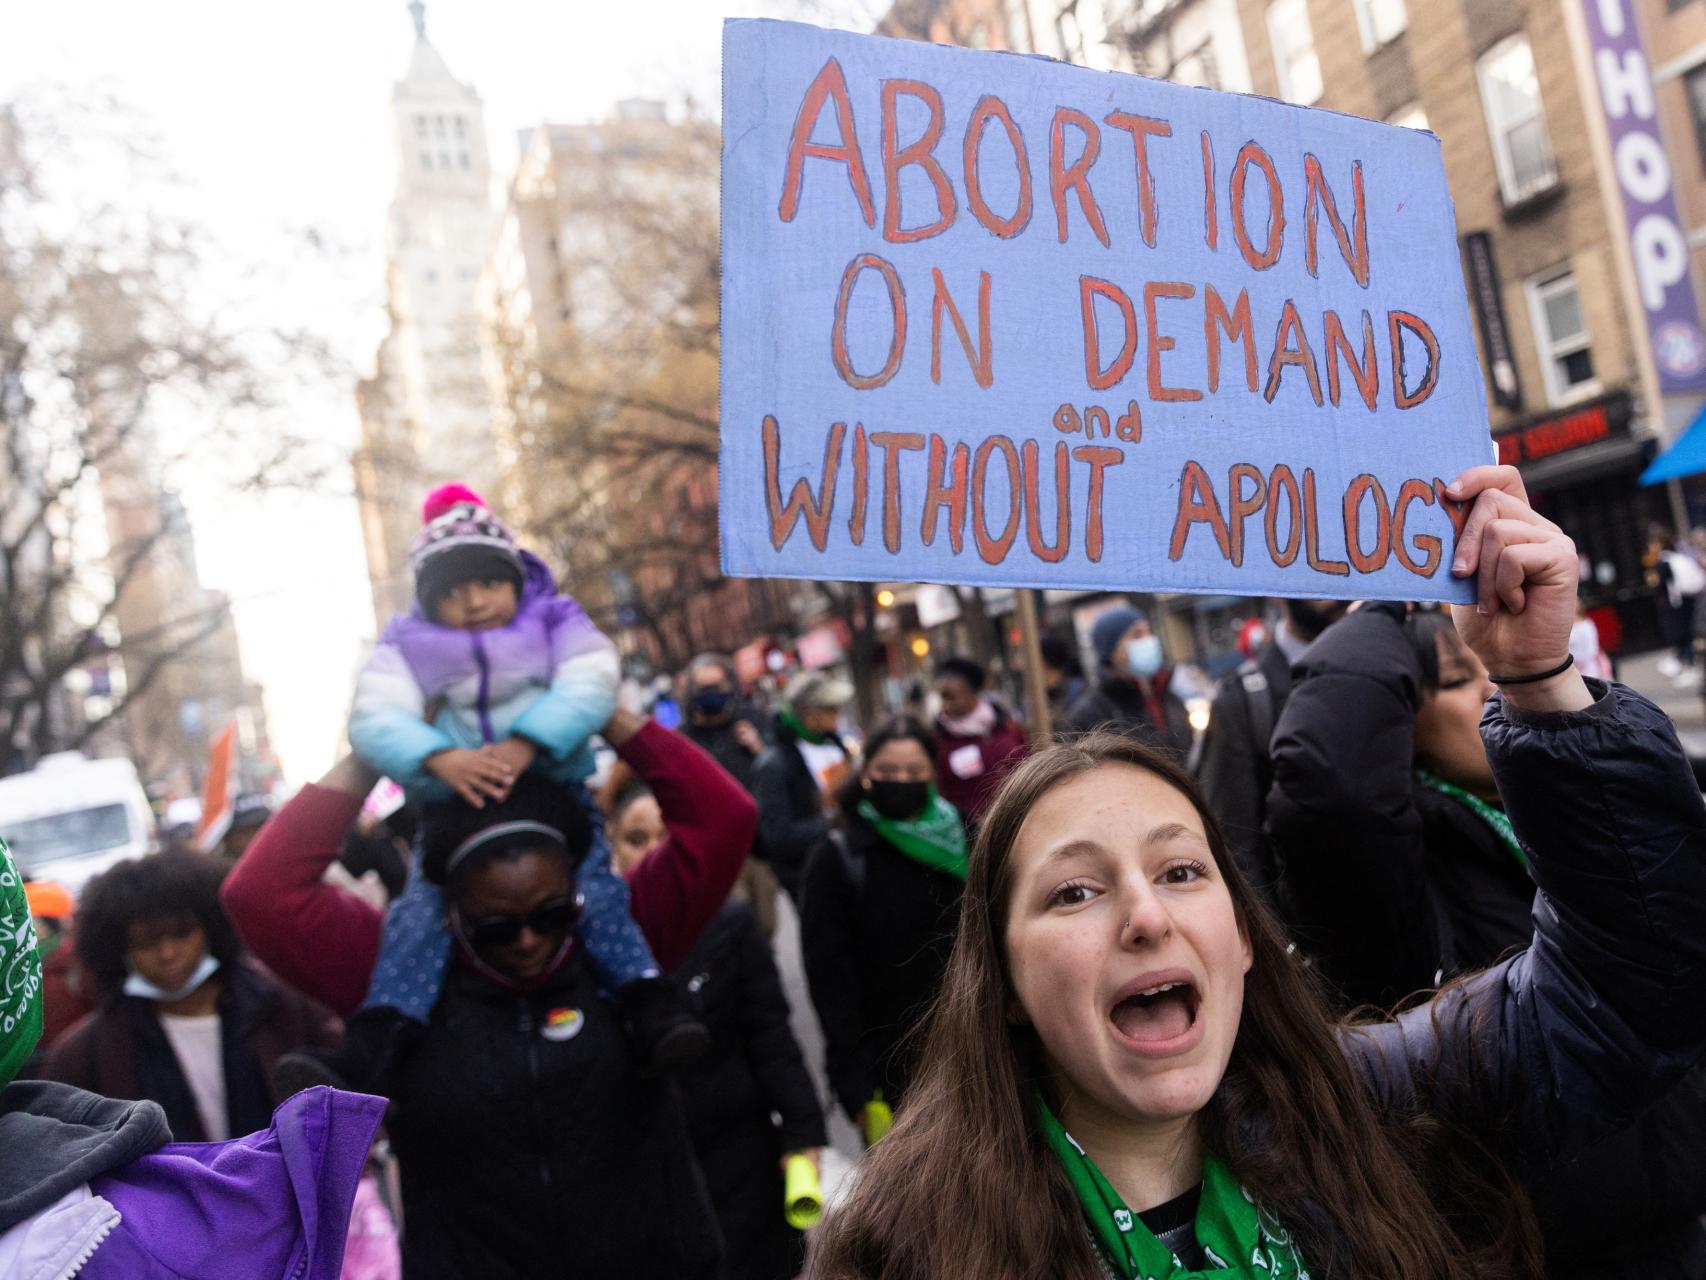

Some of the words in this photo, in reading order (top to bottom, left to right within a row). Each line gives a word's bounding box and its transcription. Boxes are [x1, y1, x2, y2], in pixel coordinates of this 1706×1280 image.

[778, 56, 1370, 289] ABORTION
[831, 253, 993, 390] ON
[1079, 274, 1442, 411] DEMAND
[762, 414, 1125, 566] WITHOUT
[1053, 400, 1143, 444] and
